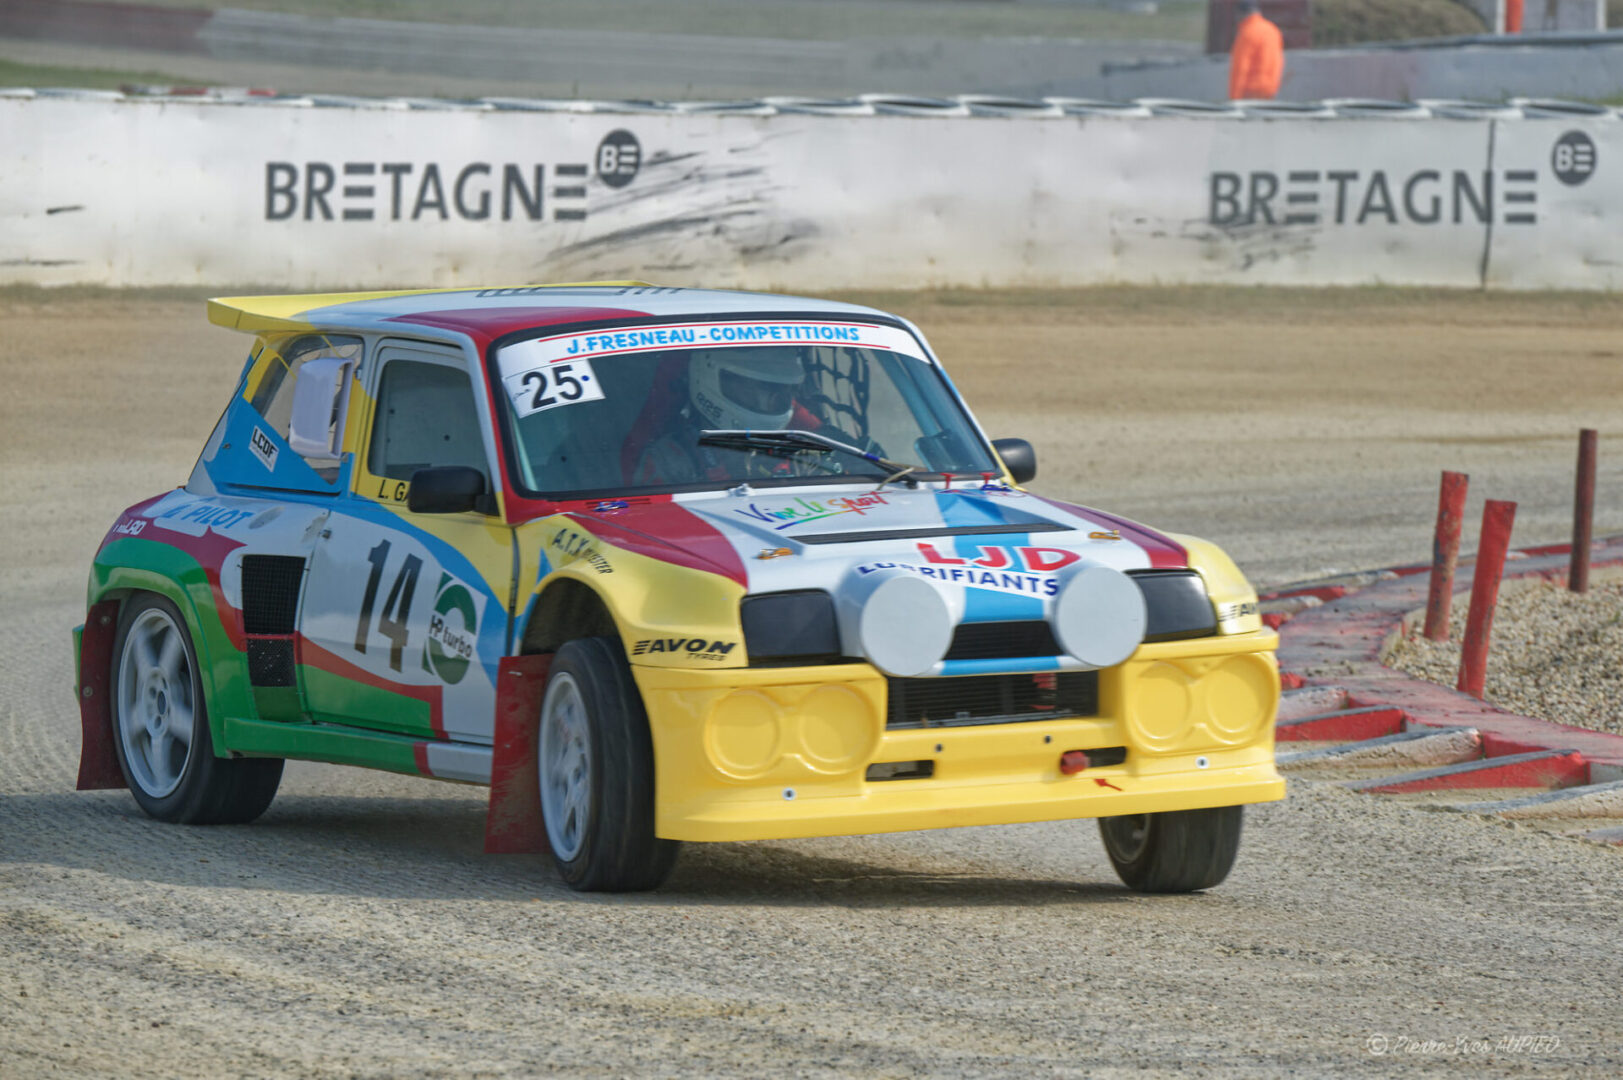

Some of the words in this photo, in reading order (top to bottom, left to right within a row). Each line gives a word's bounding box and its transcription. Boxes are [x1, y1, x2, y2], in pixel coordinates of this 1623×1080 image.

[265, 161, 588, 221] BRETAGNE
[1209, 169, 1537, 226] BRETAGNE
[521, 364, 583, 409] 25
[180, 505, 255, 529] PILOT
[916, 542, 1082, 572] LJD
[354, 538, 424, 675] 14
[649, 638, 737, 655] AVON
